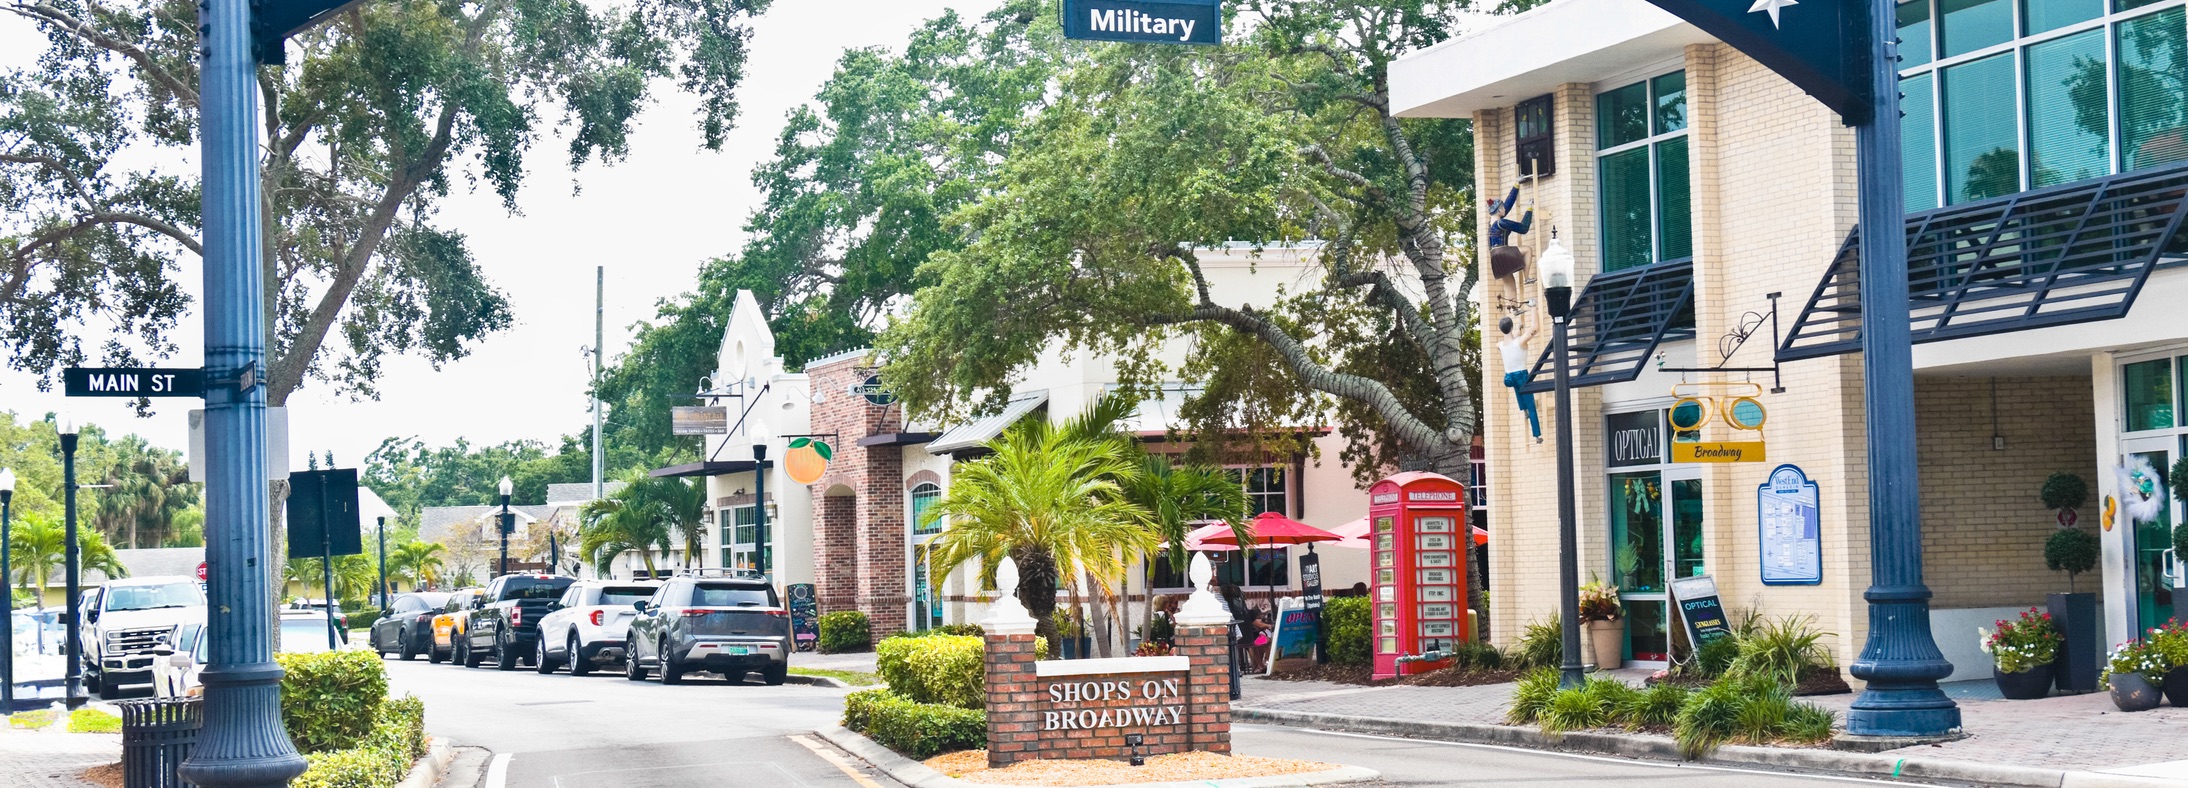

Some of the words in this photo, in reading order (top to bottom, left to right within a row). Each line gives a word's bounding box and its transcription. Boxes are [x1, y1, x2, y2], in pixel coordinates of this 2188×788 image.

[1090, 8, 1195, 42] Military
[88, 374, 139, 392] MAIN
[151, 374, 176, 392] ST
[1614, 427, 1661, 461] OPTICAL
[1694, 444, 1742, 461] Broadway
[1412, 492, 1453, 500] TELEPHONE
[198, 567, 207, 576] ST
[1309, 564, 1318, 573] ART
[1685, 599, 1718, 611] OPTICAL
[1286, 612, 1315, 624] OPEN
[1049, 680, 1131, 703] SHOPS
[1142, 679, 1179, 700] ON
[1044, 705, 1184, 731] BROADWAY
